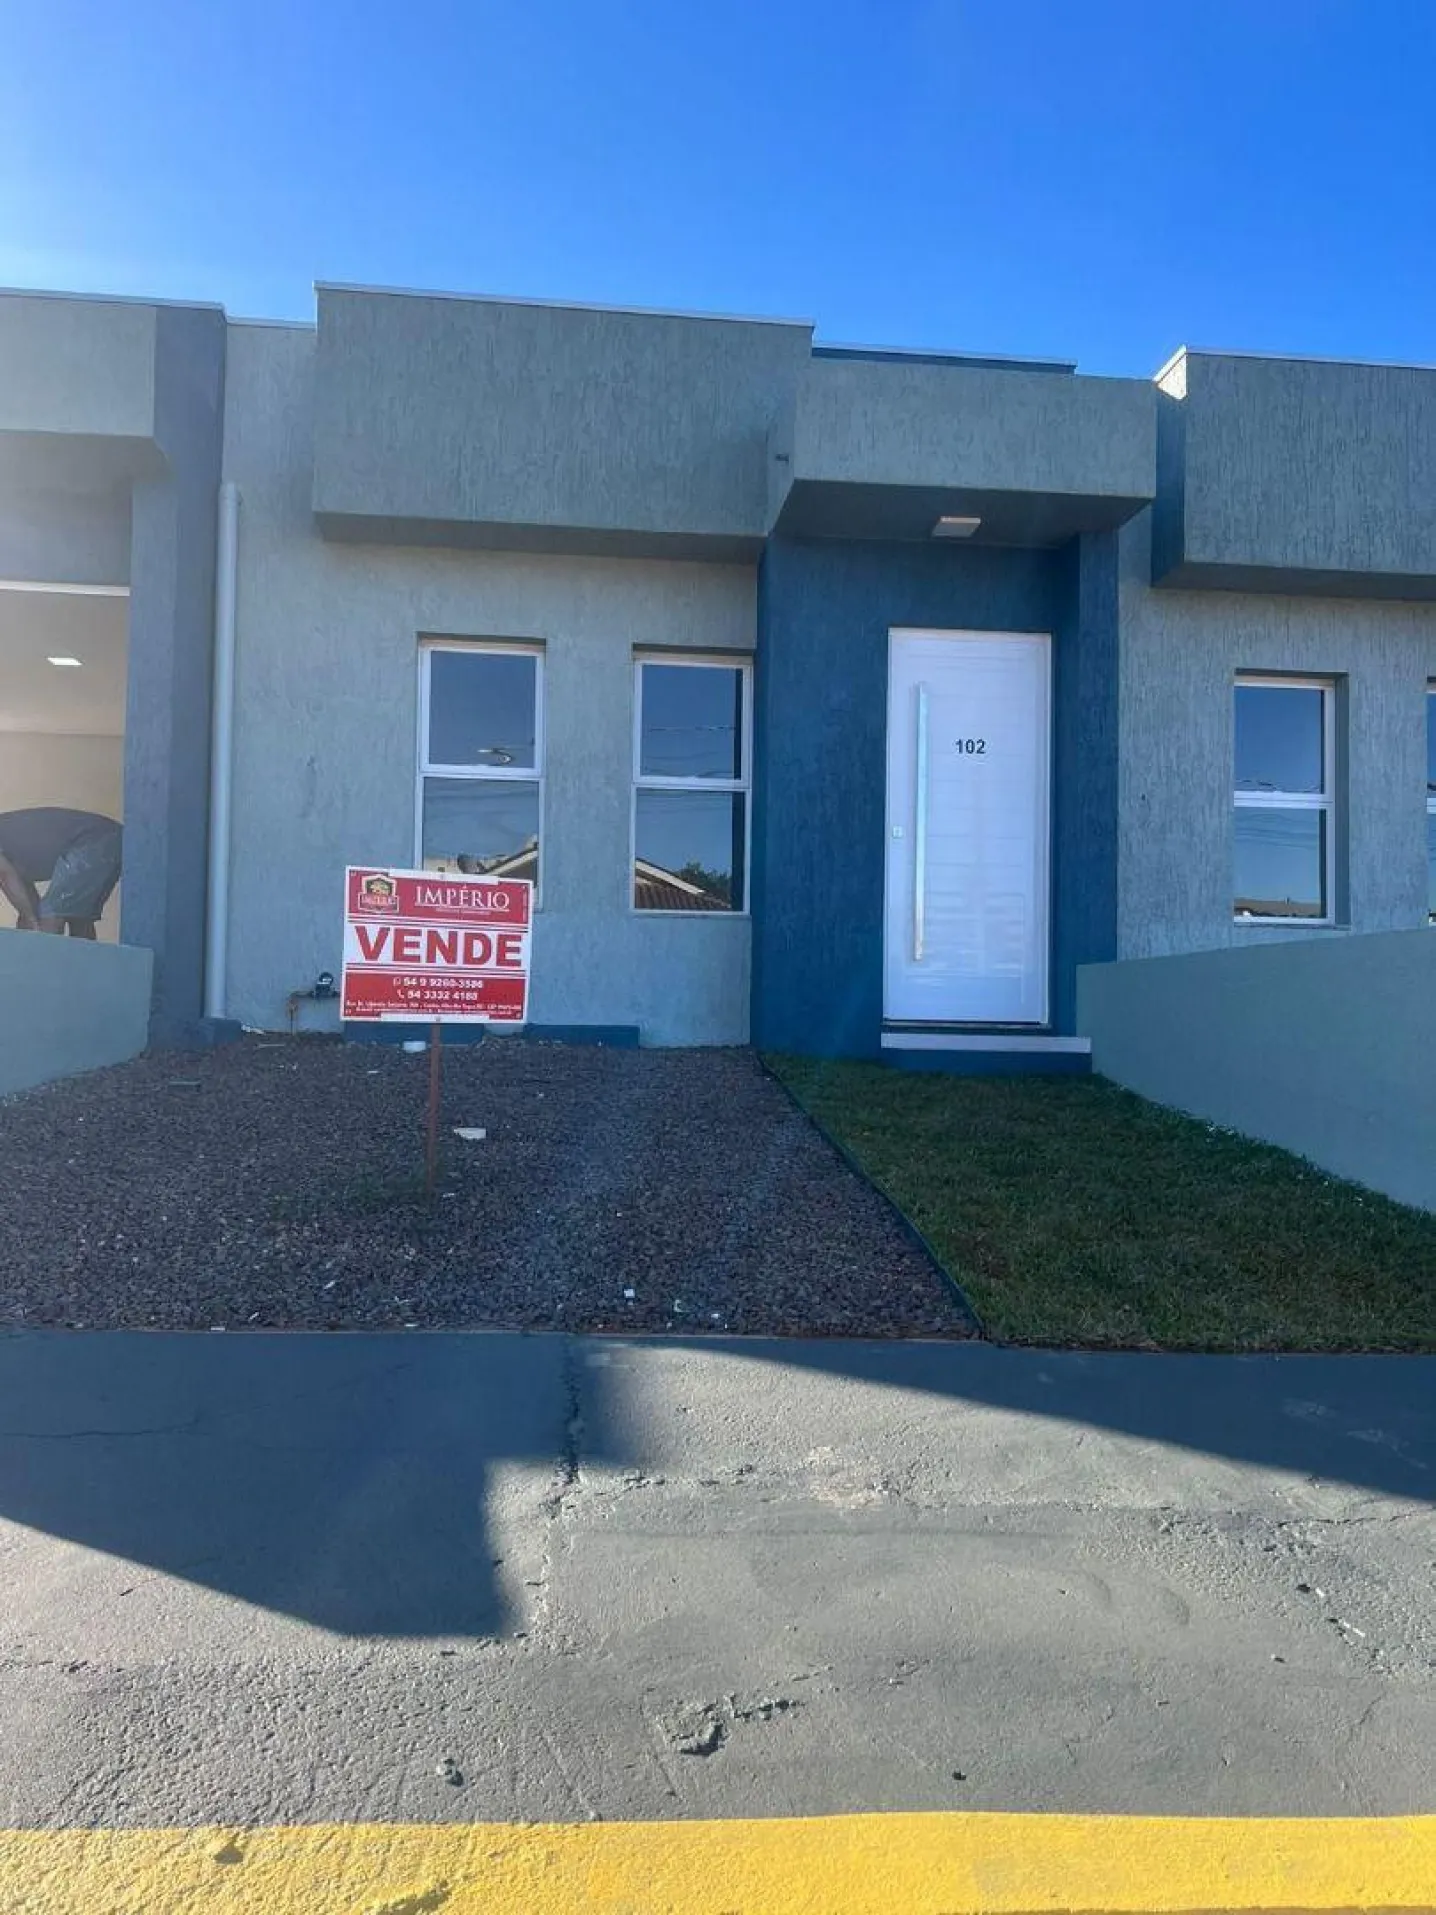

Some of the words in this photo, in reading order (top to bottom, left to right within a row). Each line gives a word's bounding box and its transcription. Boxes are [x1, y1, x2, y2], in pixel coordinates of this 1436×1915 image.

[955, 738, 986, 754] 102
[416, 885, 511, 910] IMPÉRIO
[354, 925, 523, 967] VENDE
